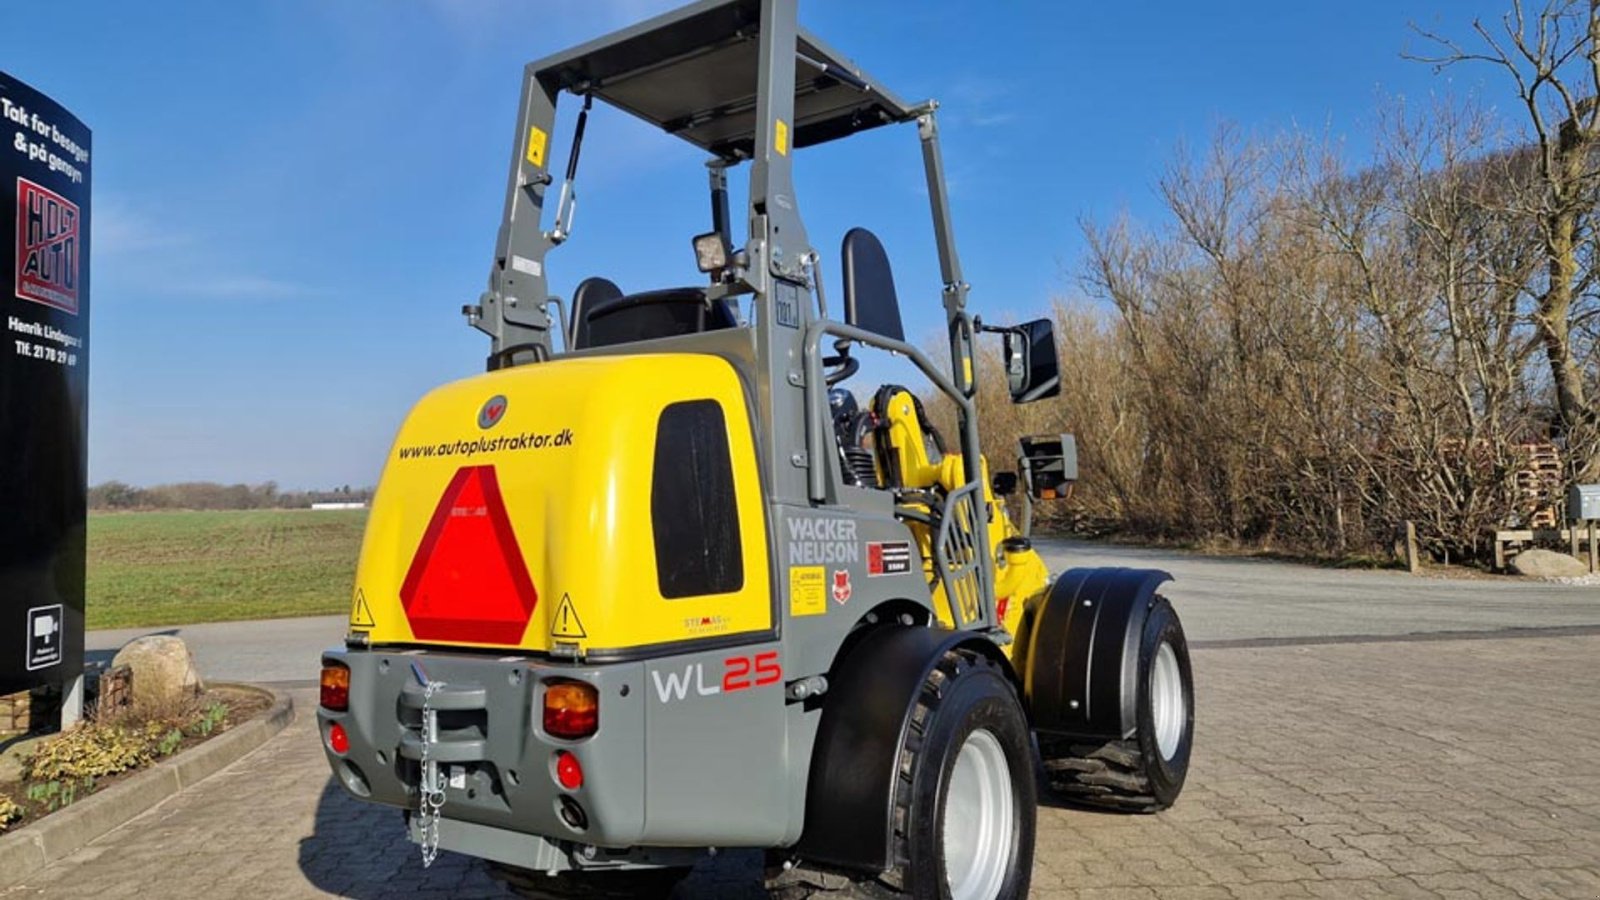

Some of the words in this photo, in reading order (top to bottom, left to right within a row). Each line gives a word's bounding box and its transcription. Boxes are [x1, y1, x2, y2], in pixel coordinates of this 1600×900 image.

[1, 97, 29, 127] Tak
[31, 113, 51, 137] for
[14, 132, 27, 153] &
[29, 143, 47, 162] på
[26, 188, 76, 249] HOLT
[23, 235, 76, 290] AUTO
[8, 316, 43, 336] Henrik
[33, 345, 44, 359] 21
[400, 428, 574, 460] www.autoplustraktor.dk
[788, 518, 857, 541] WACKER
[789, 541, 858, 564] NEUSON
